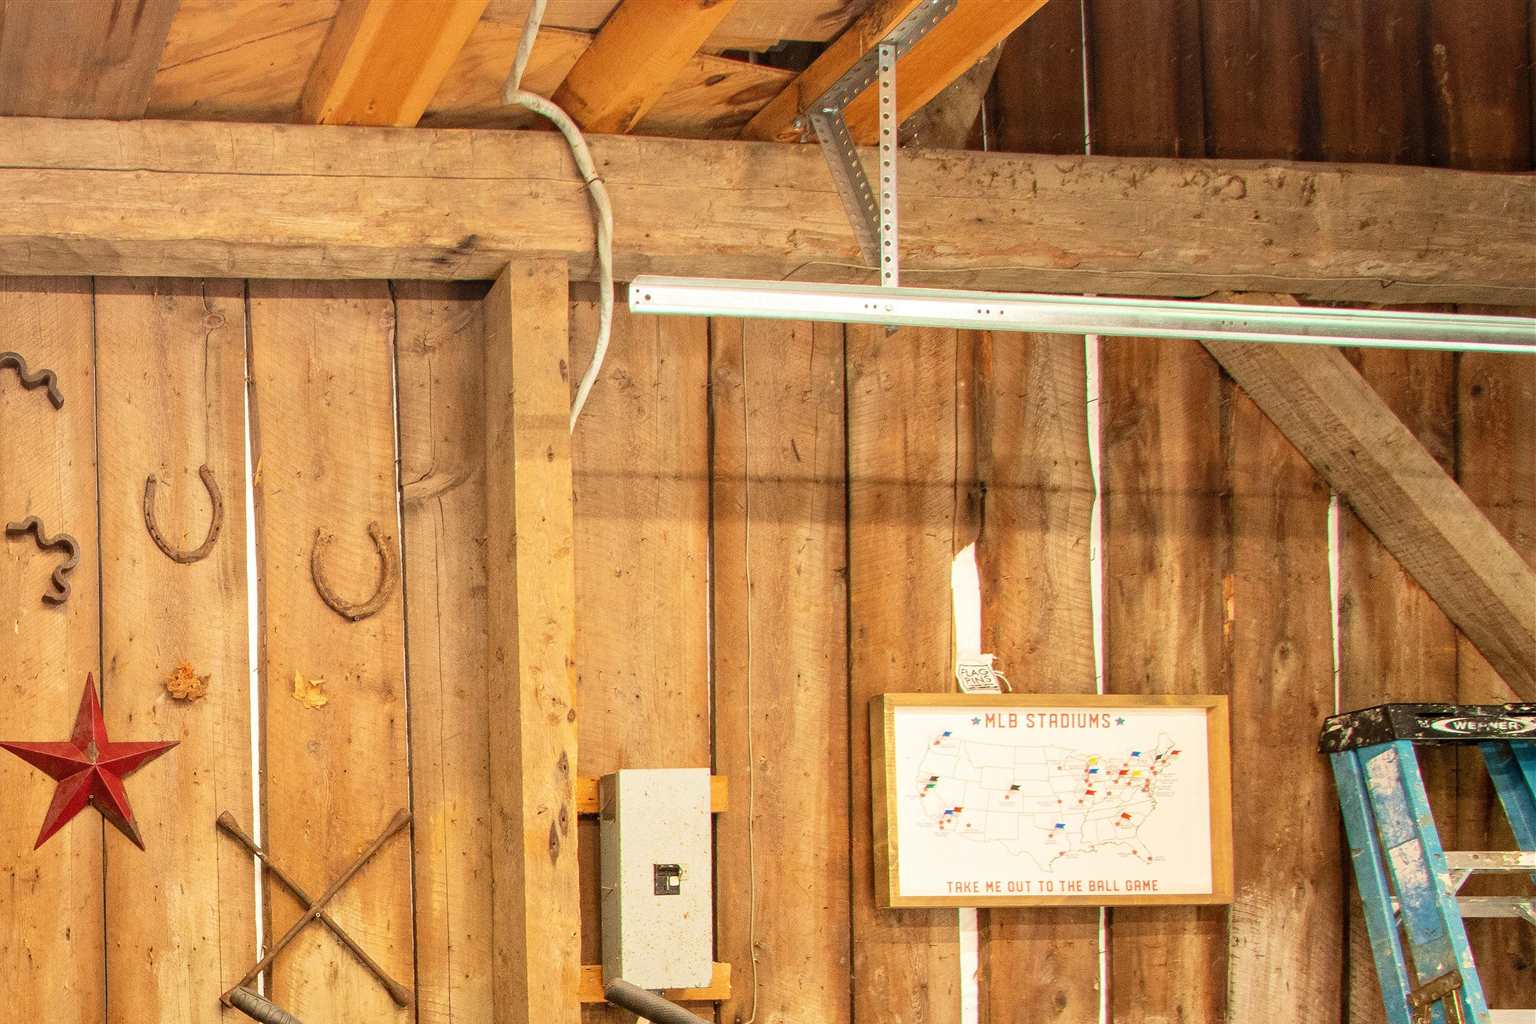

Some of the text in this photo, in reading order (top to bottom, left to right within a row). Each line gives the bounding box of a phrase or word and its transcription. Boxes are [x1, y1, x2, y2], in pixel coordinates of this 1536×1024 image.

[961, 668, 989, 677] FLAG
[964, 675, 992, 684] PINS
[985, 713, 1111, 729] MLB STADIUMS
[946, 880, 1158, 893] TAKE ME OUT TO THE BALL GAME
